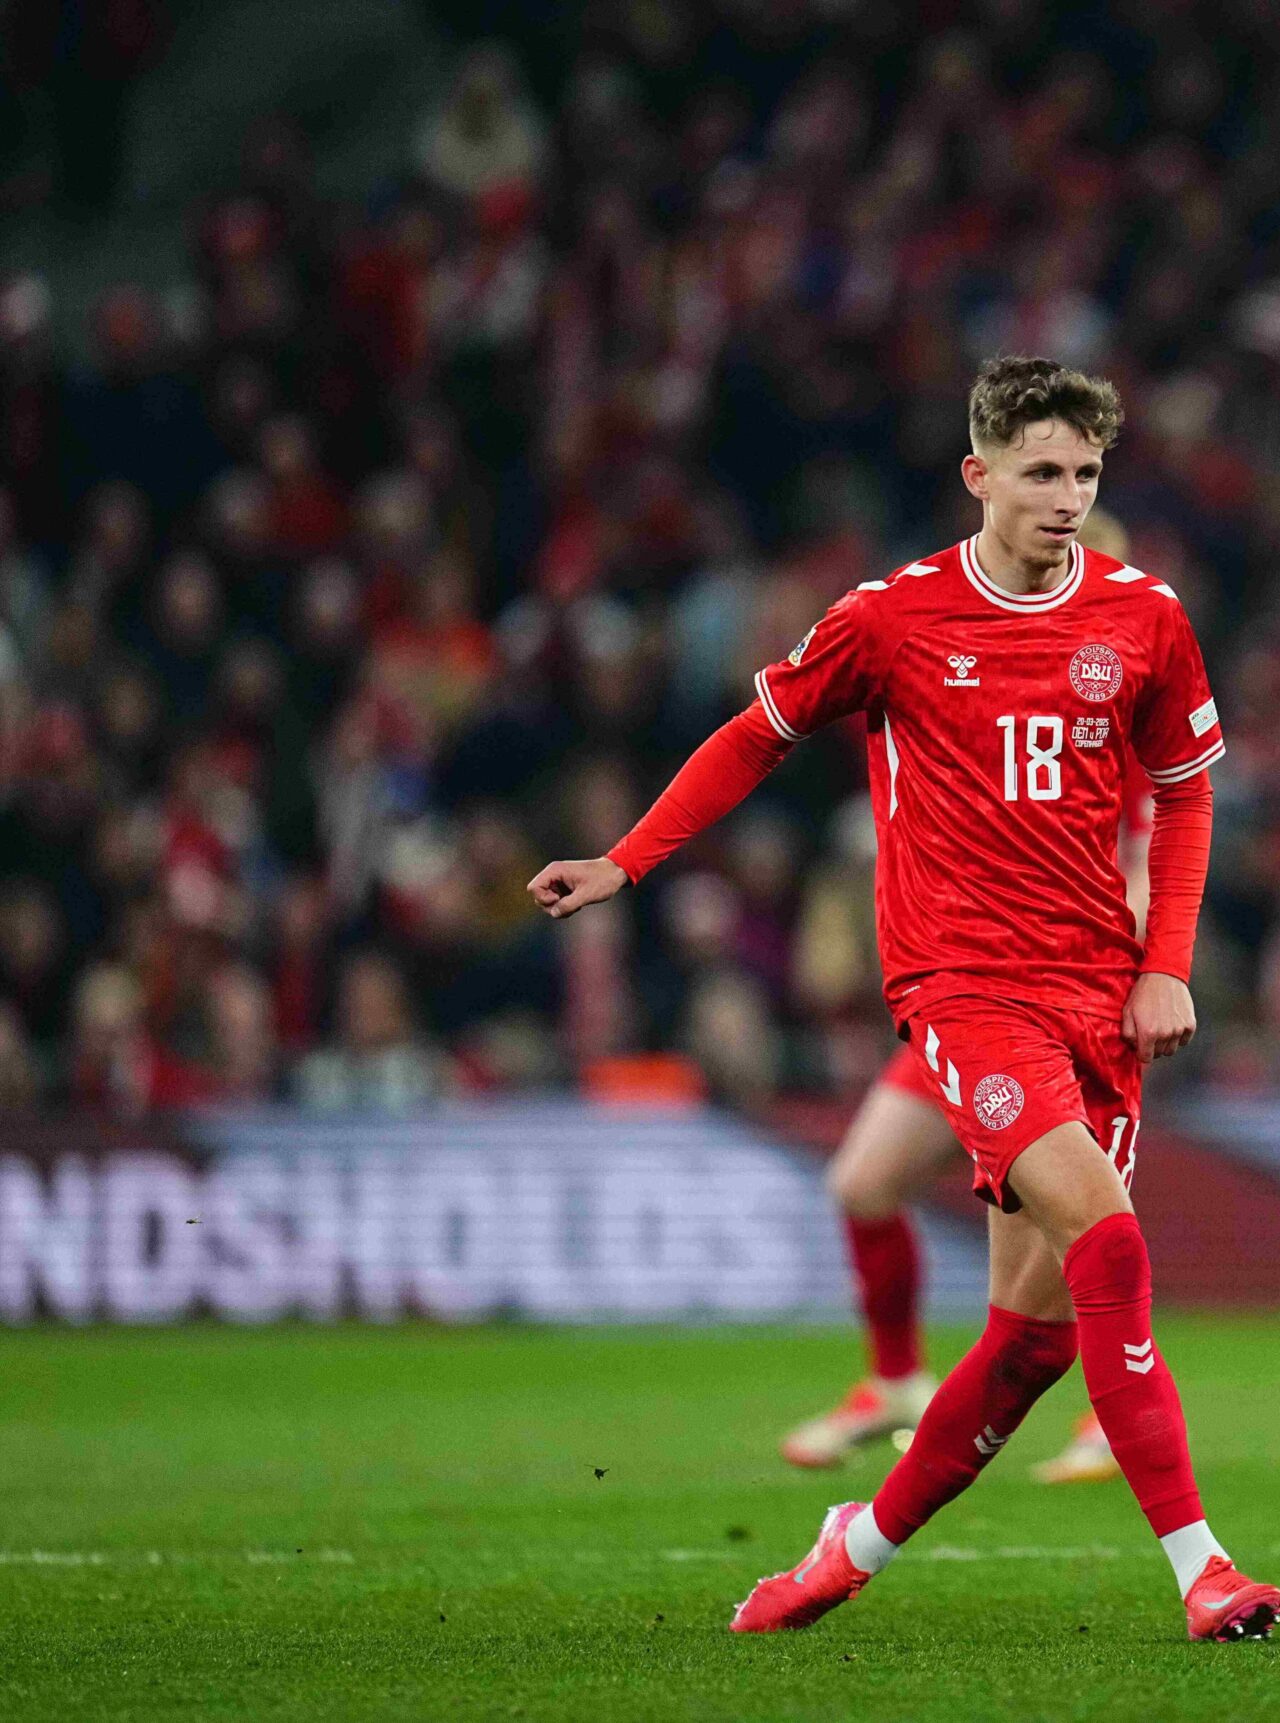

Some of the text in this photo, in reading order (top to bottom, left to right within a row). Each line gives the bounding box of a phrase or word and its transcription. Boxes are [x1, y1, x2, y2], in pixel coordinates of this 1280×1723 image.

[1080, 663, 1112, 681] DBU
[944, 676, 980, 687] hummel
[1071, 726, 1089, 740] DEN
[997, 715, 1064, 801] 18
[981, 1086, 1013, 1117] DBU
